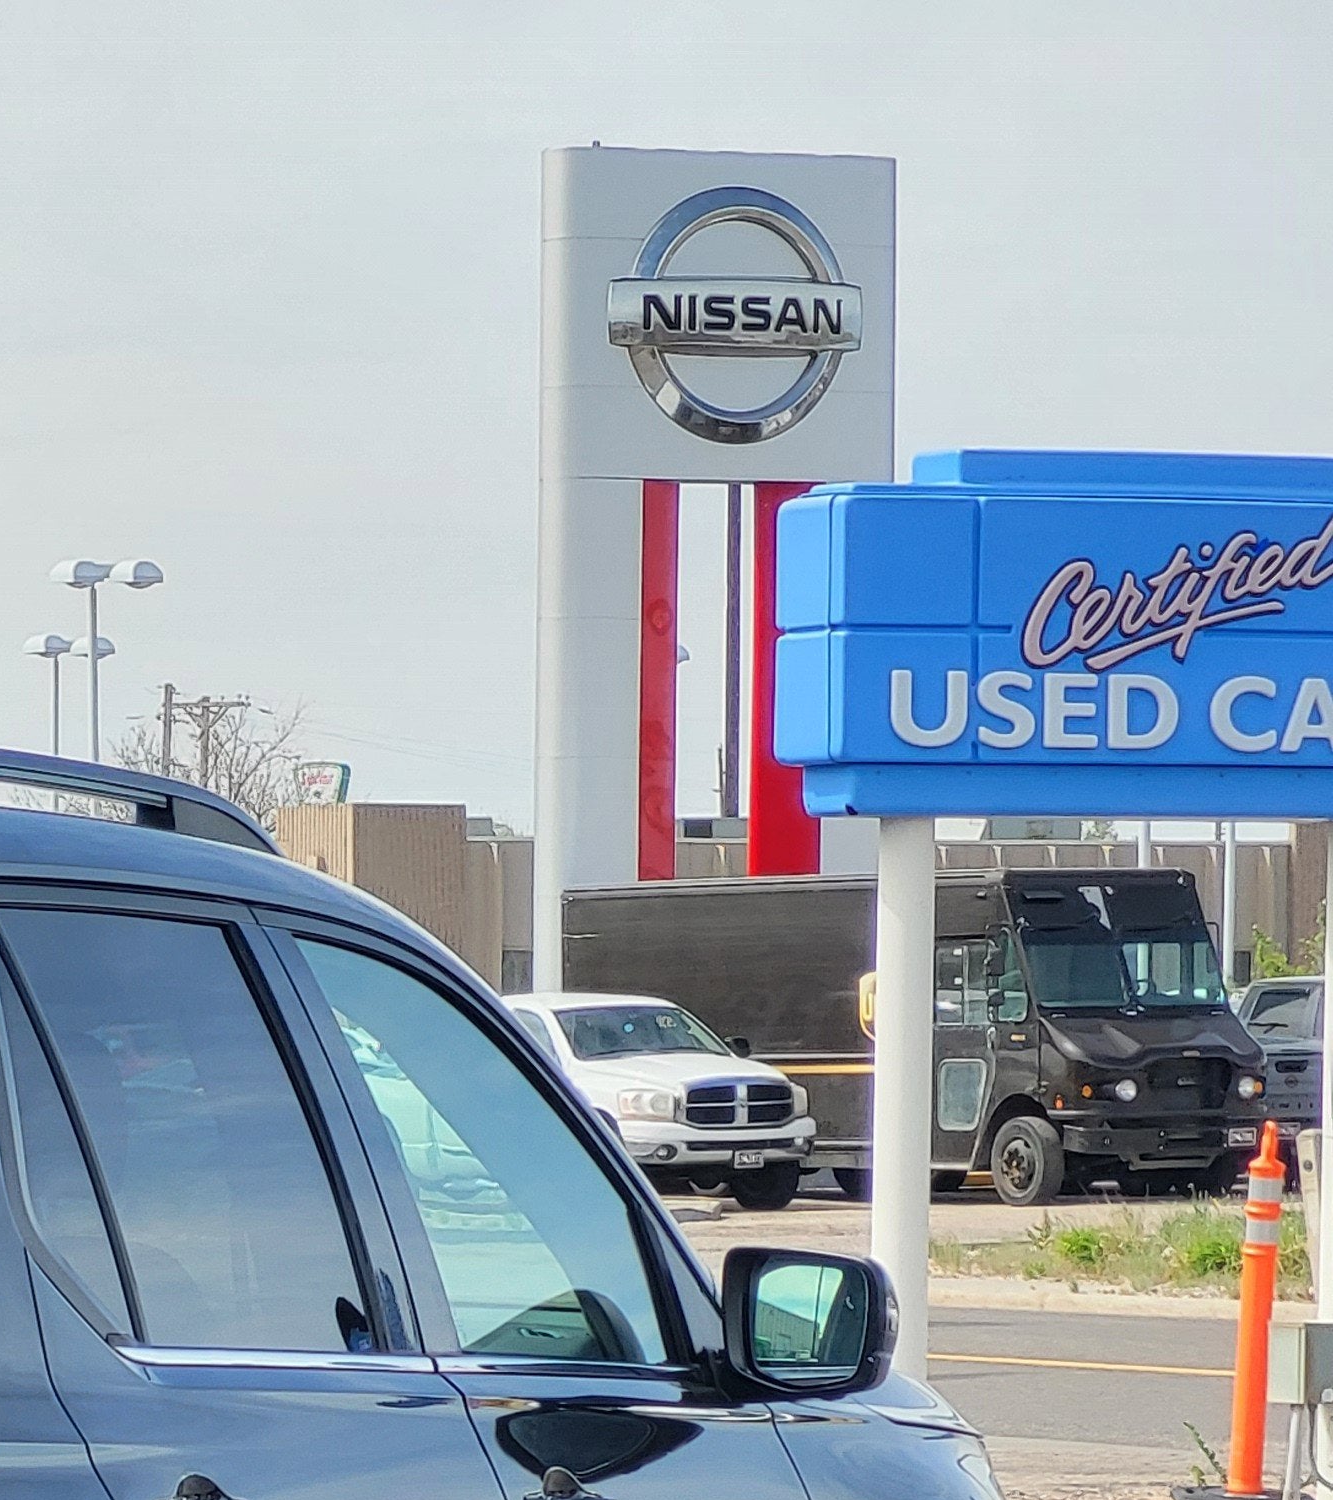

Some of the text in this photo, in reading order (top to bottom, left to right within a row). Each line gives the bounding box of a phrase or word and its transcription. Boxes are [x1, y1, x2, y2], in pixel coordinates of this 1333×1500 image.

[641, 291, 843, 335] NISSAN
[1021, 512, 1333, 672] Certified
[890, 668, 1179, 750] USED
